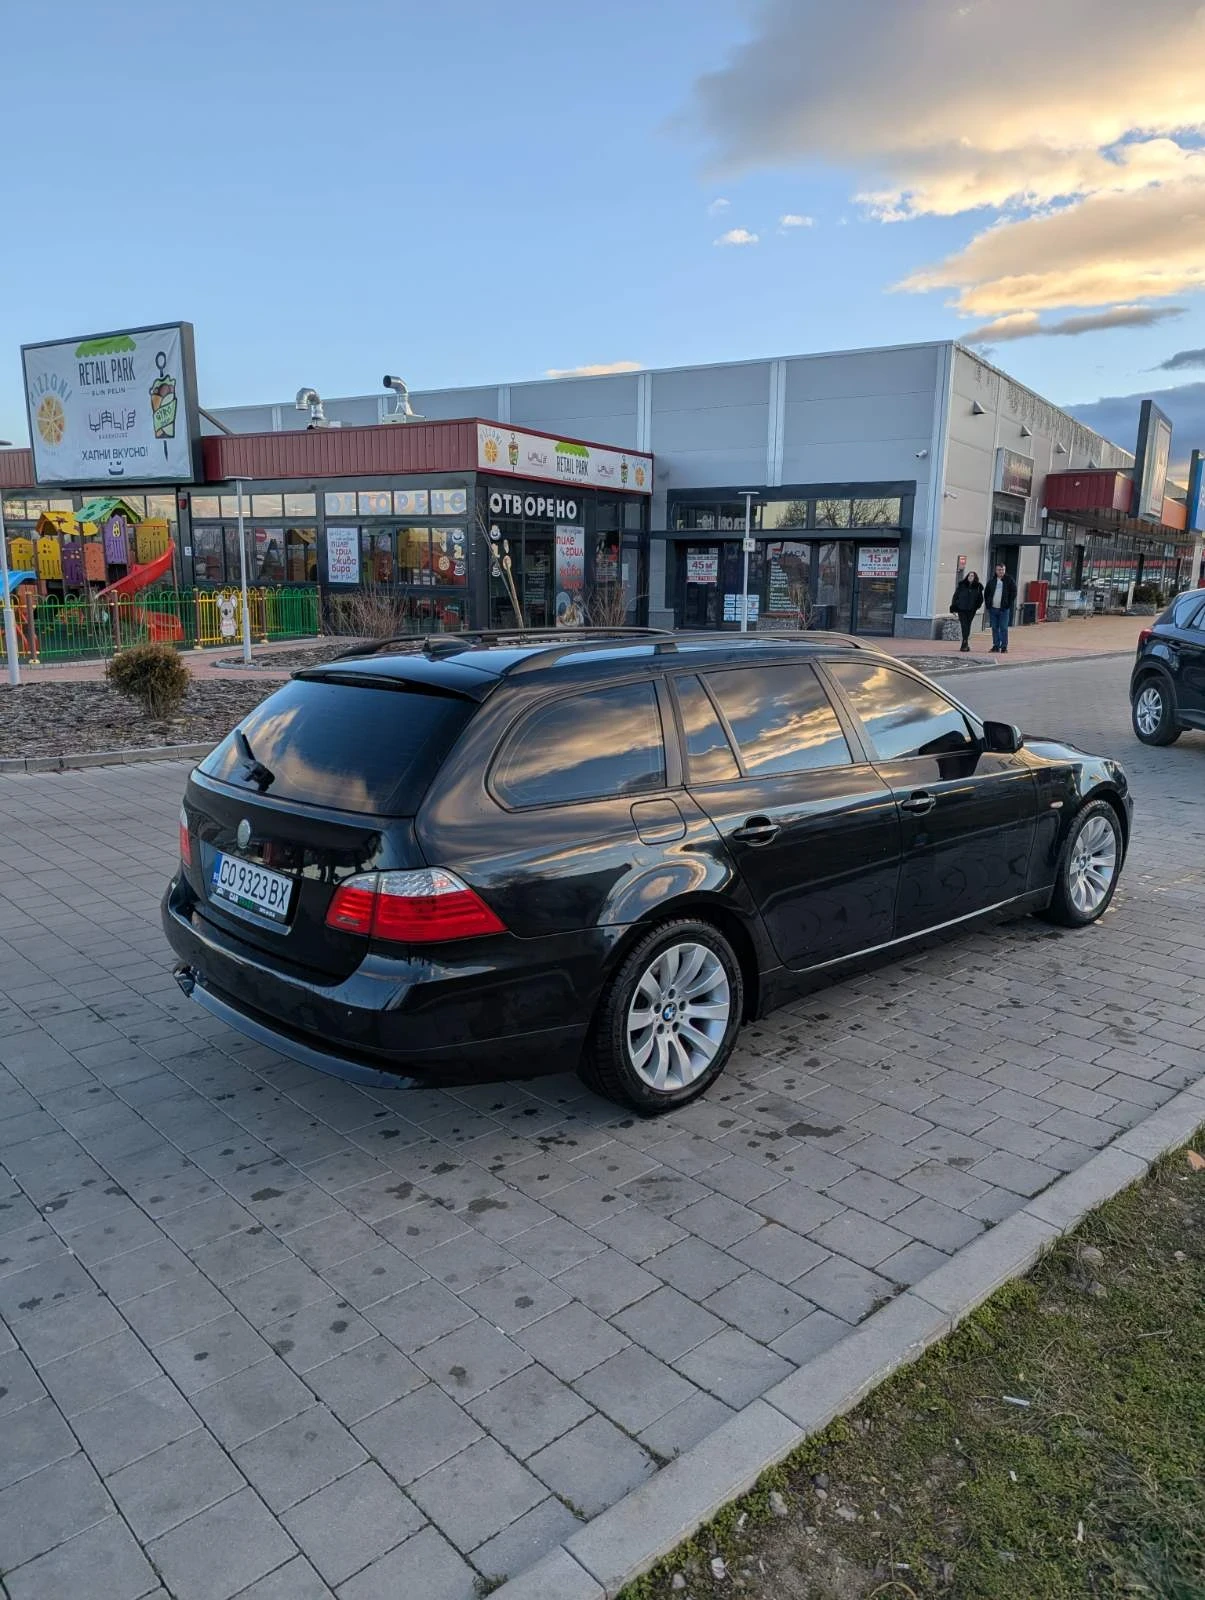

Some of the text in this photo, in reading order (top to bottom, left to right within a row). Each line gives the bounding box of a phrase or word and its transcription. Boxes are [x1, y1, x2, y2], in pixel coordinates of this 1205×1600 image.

[79, 356, 135, 386] RETAIL PARK
[82, 446, 148, 460] ХАПНИ ВКУСНО!
[556, 456, 574, 474] RETAIL
[575, 459, 588, 476] PARK
[490, 493, 577, 519] ОТВОРЕНО
[691, 561, 704, 569] 45
[868, 554, 881, 563] 15
